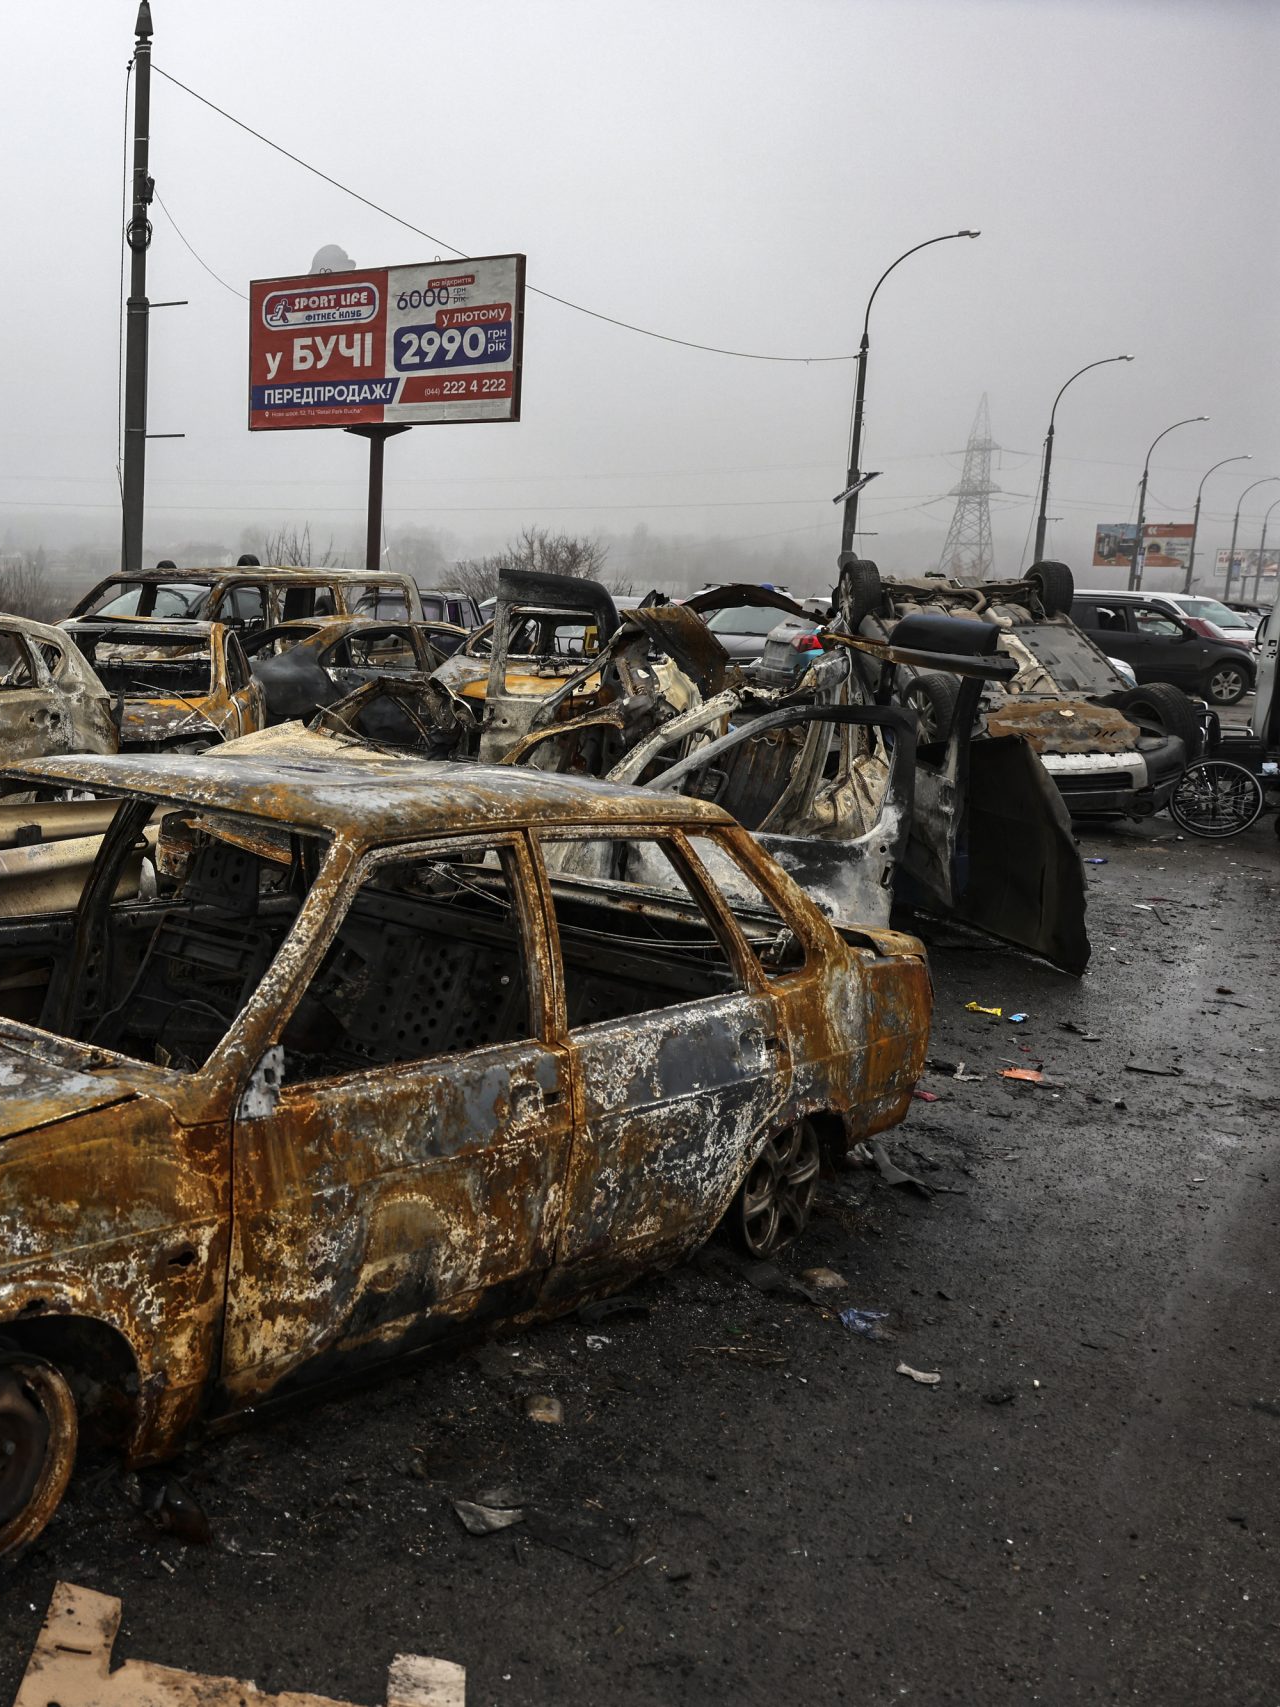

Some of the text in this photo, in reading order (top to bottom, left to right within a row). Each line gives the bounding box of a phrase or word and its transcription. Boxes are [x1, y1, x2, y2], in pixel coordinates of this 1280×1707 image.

[441, 277, 472, 286] відкриття
[397, 287, 450, 311] 6000
[453, 287, 466, 295] грн
[453, 294, 466, 304] рік
[294, 291, 368, 310] SPORT LIFE
[305, 310, 362, 322] ФІТНЕС КЛУБ
[452, 307, 507, 323] лютому
[487, 328, 507, 340] грн
[292, 332, 373, 371] БУЧІ
[400, 326, 486, 365] 2990
[487, 340, 506, 355] рік
[264, 382, 392, 405] ПЕРЕДПРОДАЖ!
[424, 378, 506, 397] (044) 222 4 222
